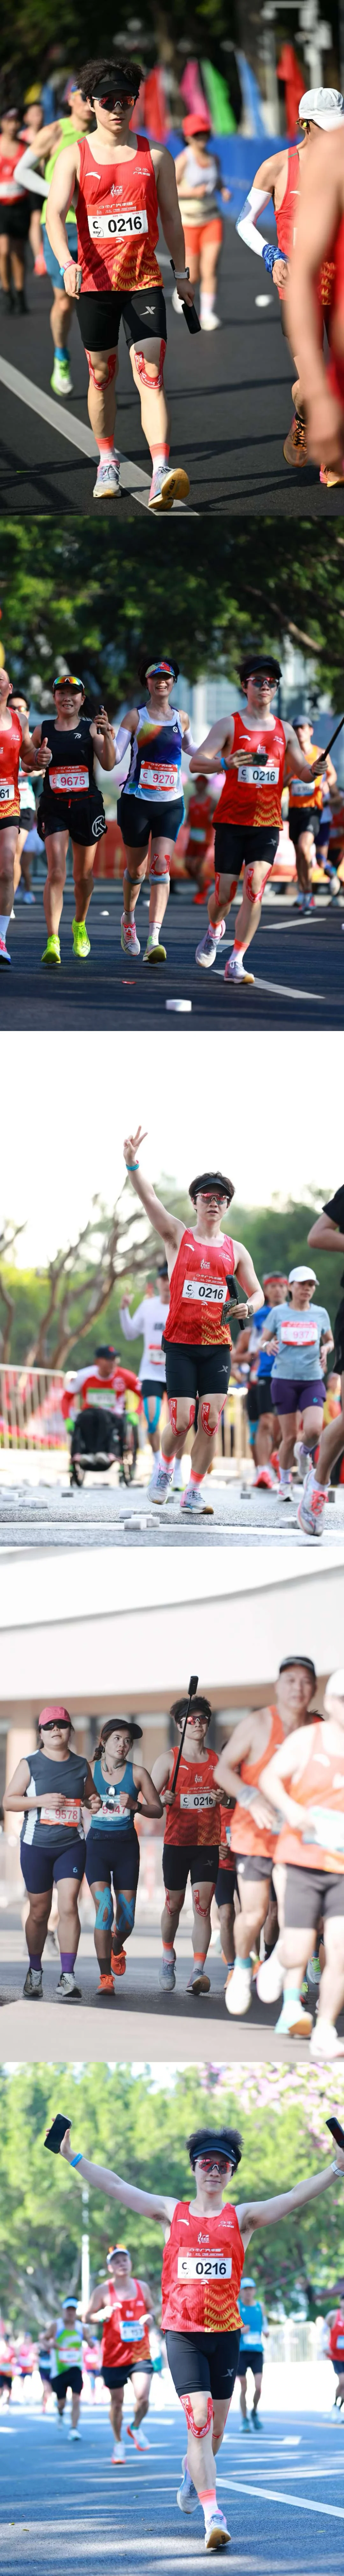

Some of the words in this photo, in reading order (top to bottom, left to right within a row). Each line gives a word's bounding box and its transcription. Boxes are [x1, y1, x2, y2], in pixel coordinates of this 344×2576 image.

[108, 216, 142, 232] 0216
[61, 776, 85, 786] 9675
[153, 774, 174, 784] 9270
[253, 771, 275, 781] 0216
[0, 789, 9, 798] 61
[199, 1286, 224, 1299] 0216
[194, 1796, 213, 1806] 0216
[55, 1809, 77, 1820] 9578
[196, 2262, 226, 2275] 0216
